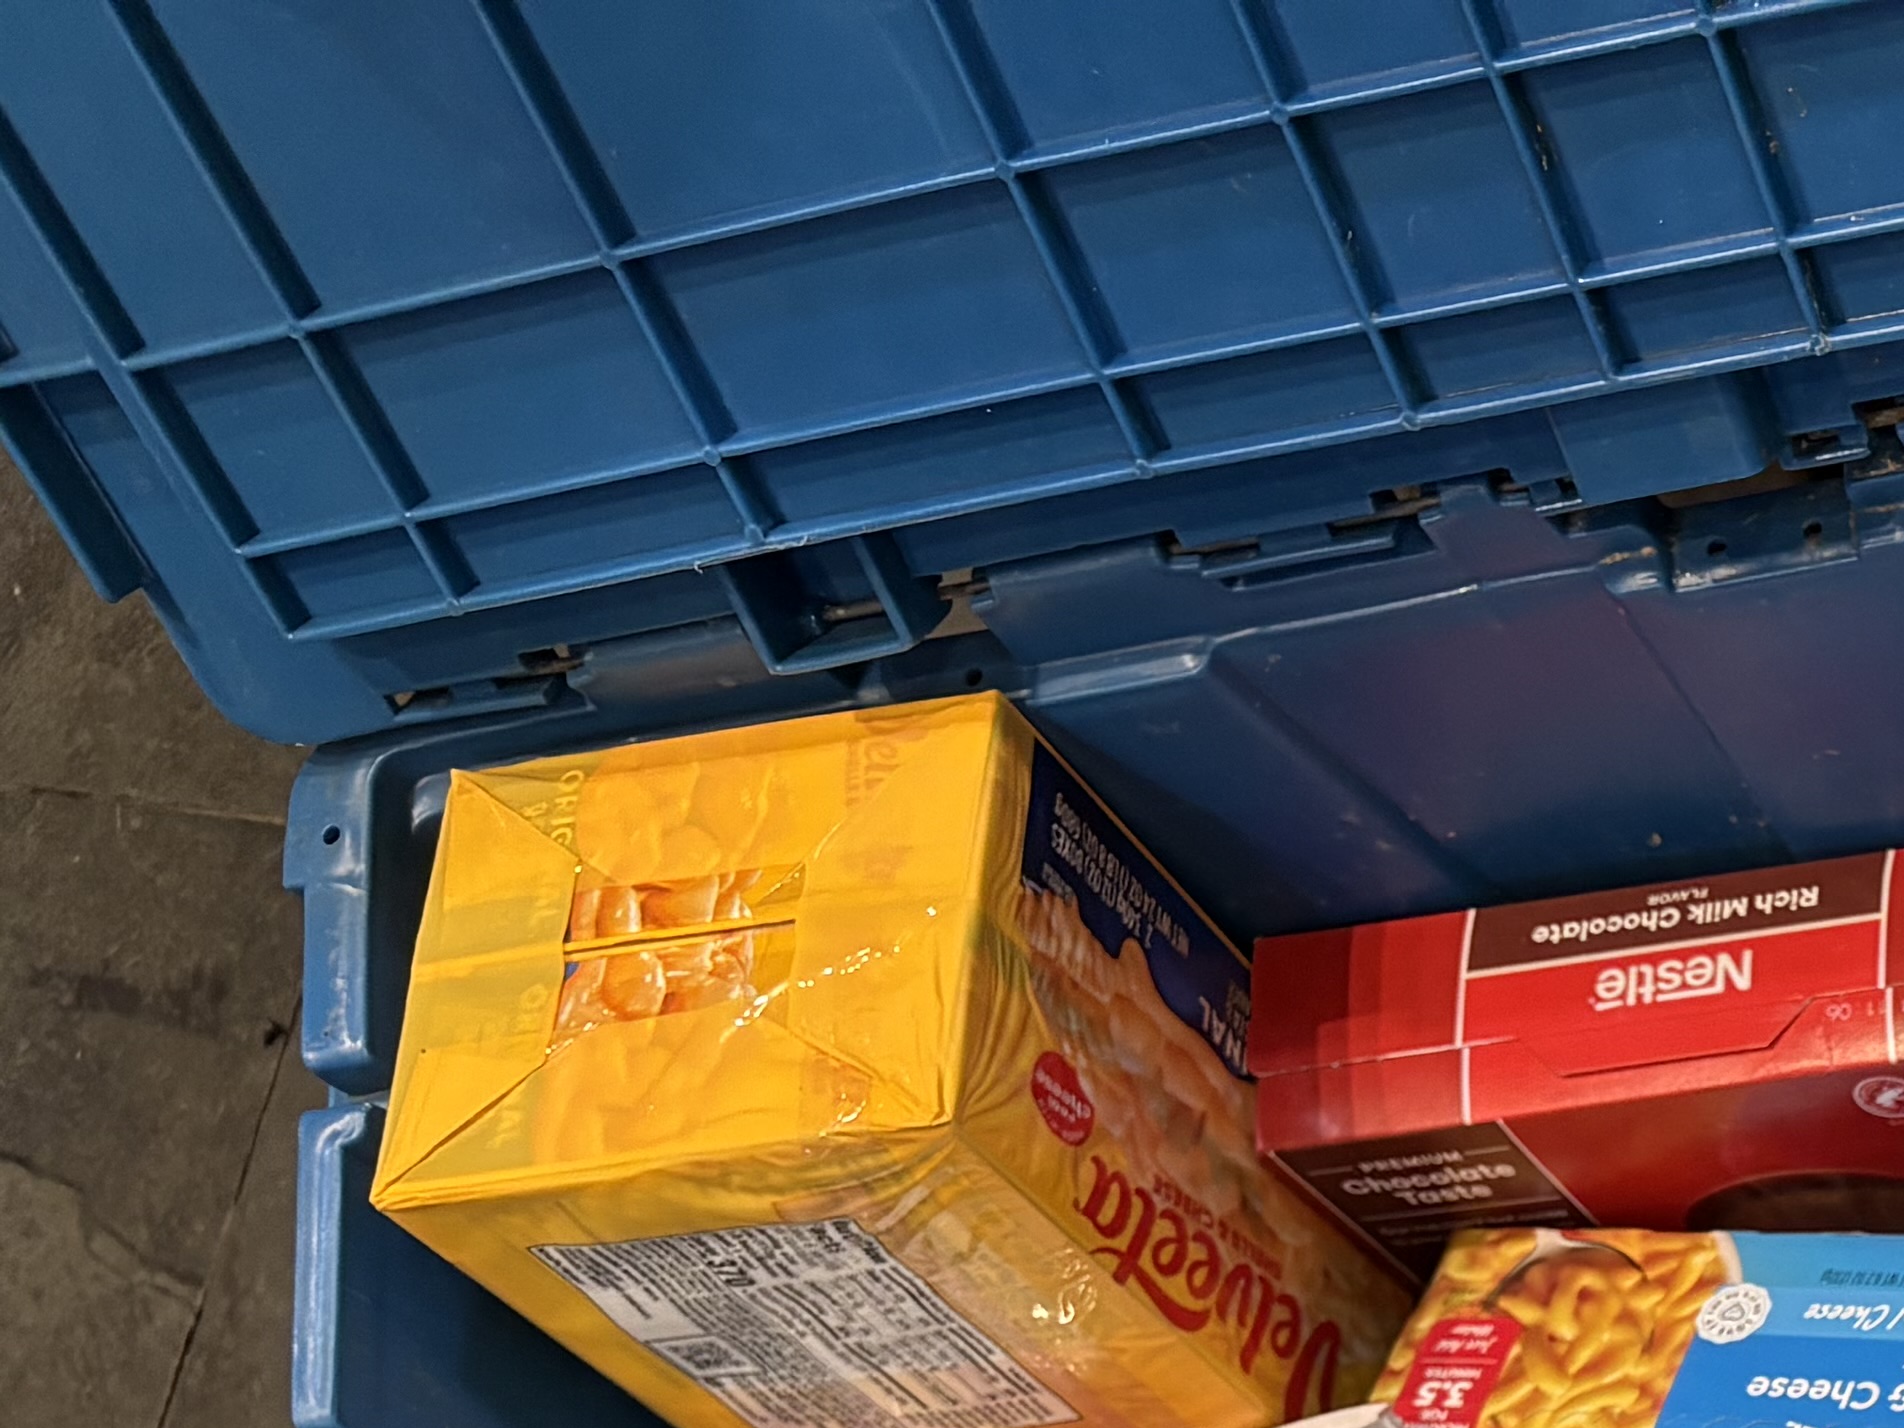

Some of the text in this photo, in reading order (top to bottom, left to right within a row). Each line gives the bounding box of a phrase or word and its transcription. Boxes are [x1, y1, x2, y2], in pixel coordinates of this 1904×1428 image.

[1531, 885, 1820, 944] Rich Milk Chocolate
[1358, 1151, 1464, 1175] PREMIUM
[1341, 1161, 1517, 1198] Chocolate
[1394, 1179, 1494, 1206] Taste
[1074, 1153, 1342, 1422] Velveeta
[1803, 1302, 1890, 1330] Cheese
[1412, 1380, 1474, 1408] 3.5
[1746, 1375, 1881, 1411] Cheese
